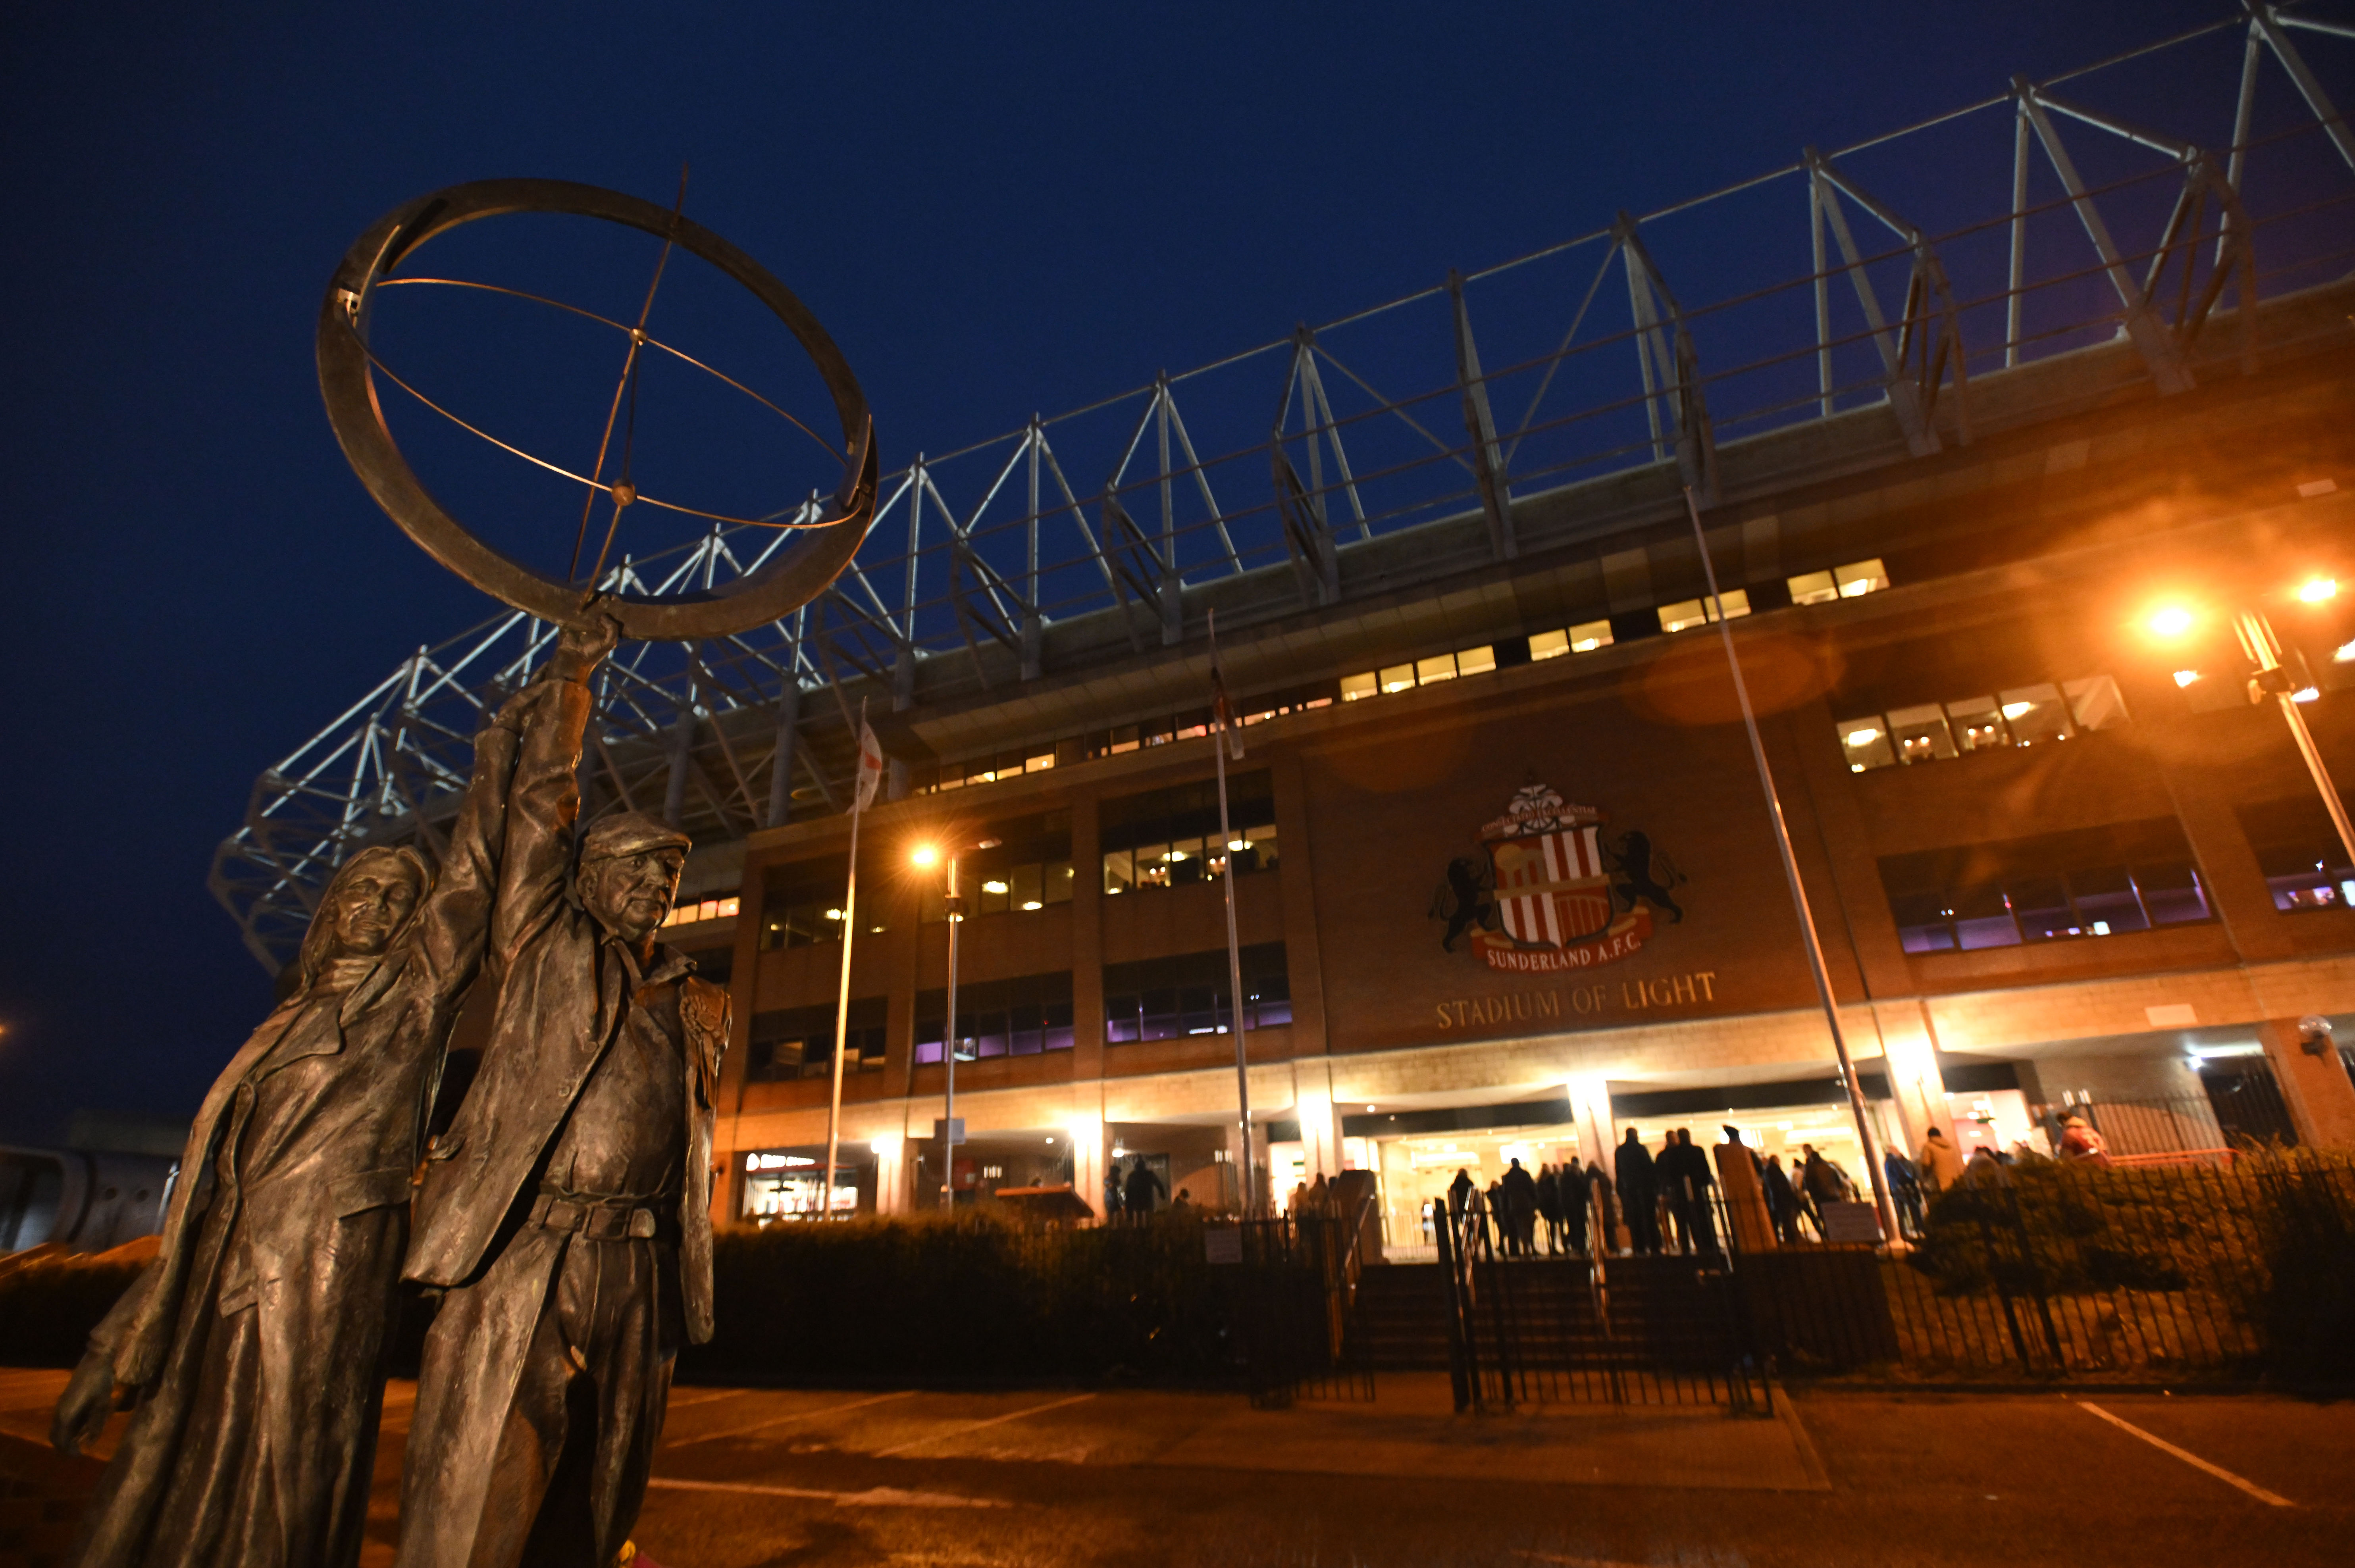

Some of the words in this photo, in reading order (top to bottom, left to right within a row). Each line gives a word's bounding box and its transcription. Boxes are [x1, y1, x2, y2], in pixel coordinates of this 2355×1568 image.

[1487, 949, 1590, 971] SUNDERLAND
[1598, 931, 1641, 962] A.F.C.
[1436, 991, 1560, 1029] STADIUM
[1572, 984, 1606, 1014] OF
[1622, 971, 1716, 1009] LIGHT
